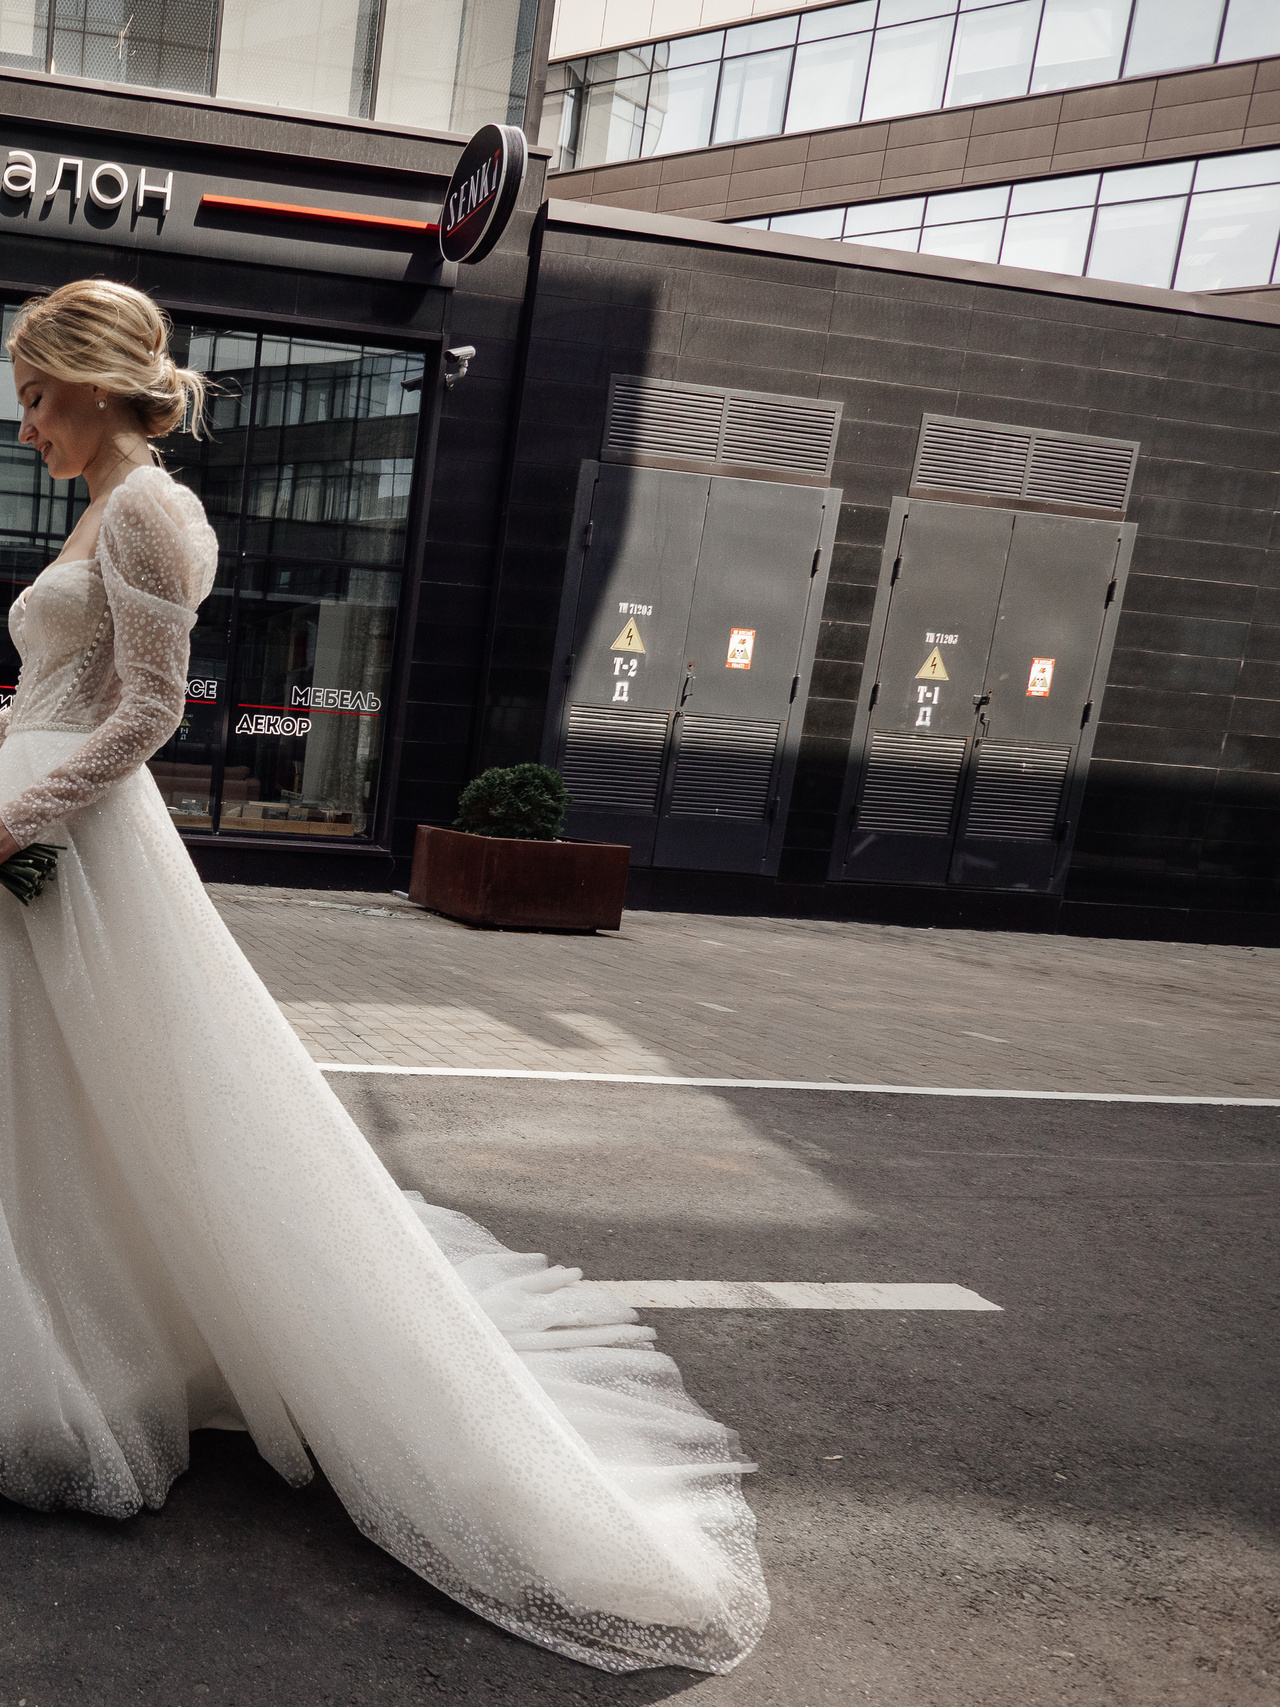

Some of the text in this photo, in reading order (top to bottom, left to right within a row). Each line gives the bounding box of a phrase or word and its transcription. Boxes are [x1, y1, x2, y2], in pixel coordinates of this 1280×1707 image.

[446, 149, 500, 231] SENKI
[629, 603, 653, 616] 71203
[935, 633, 959, 645] 71203
[291, 686, 382, 712] МЕБЕЛЬ
[235, 714, 312, 737] ДЕКОР
